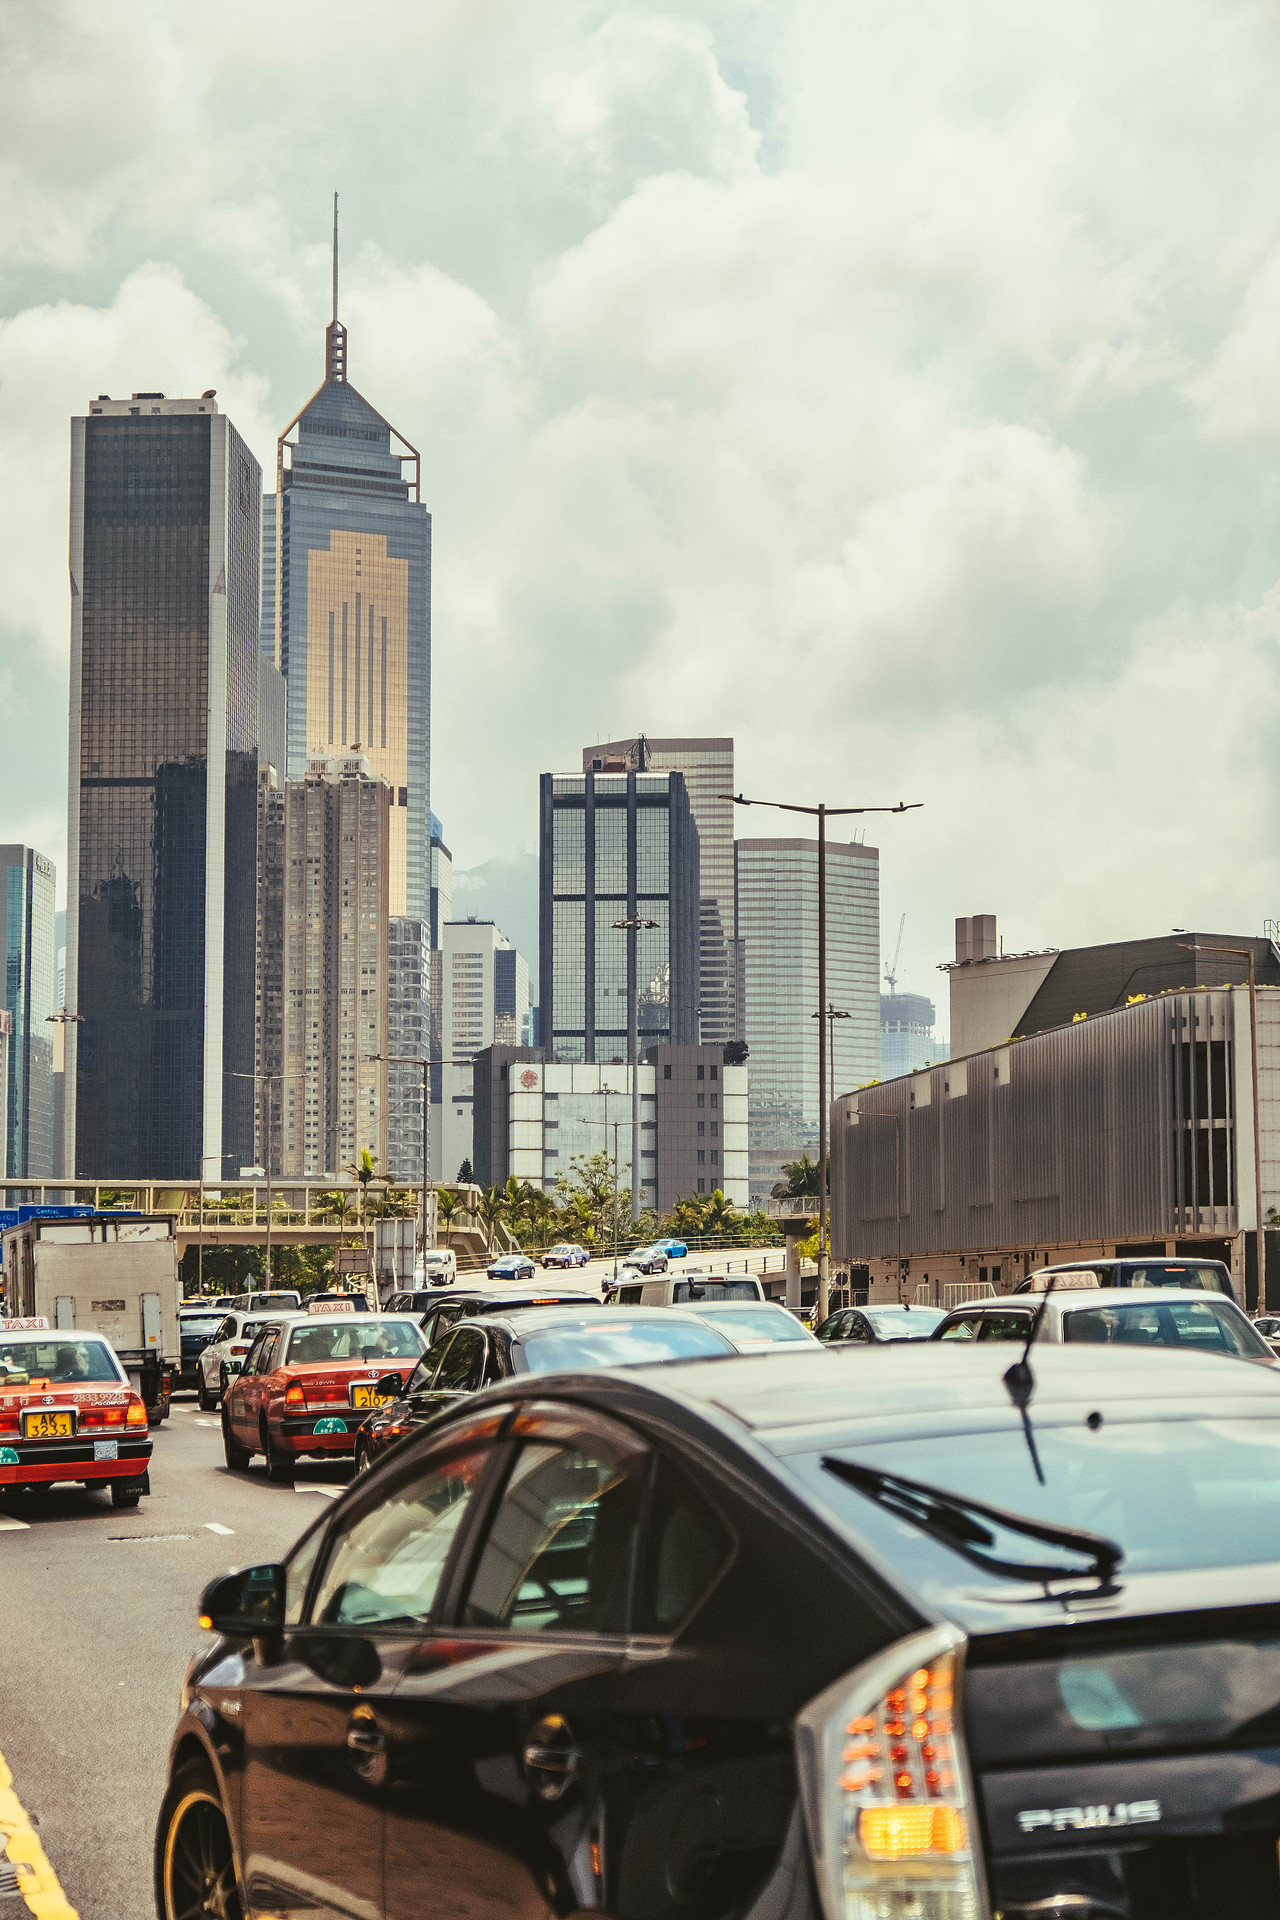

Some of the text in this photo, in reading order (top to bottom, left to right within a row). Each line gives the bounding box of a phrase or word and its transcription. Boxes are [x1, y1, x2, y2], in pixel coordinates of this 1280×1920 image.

[1040, 1273, 1093, 1289] TAXI
[312, 1302, 351, 1313] TAXI
[1, 1318, 44, 1329] TAXI
[72, 1391, 125, 1403] 2833 9928
[39, 1413, 58, 1426] AK
[326, 1421, 334, 1429] 4
[31, 1424, 68, 1438] 3233
[1017, 1799, 1163, 1833] PRIUS
